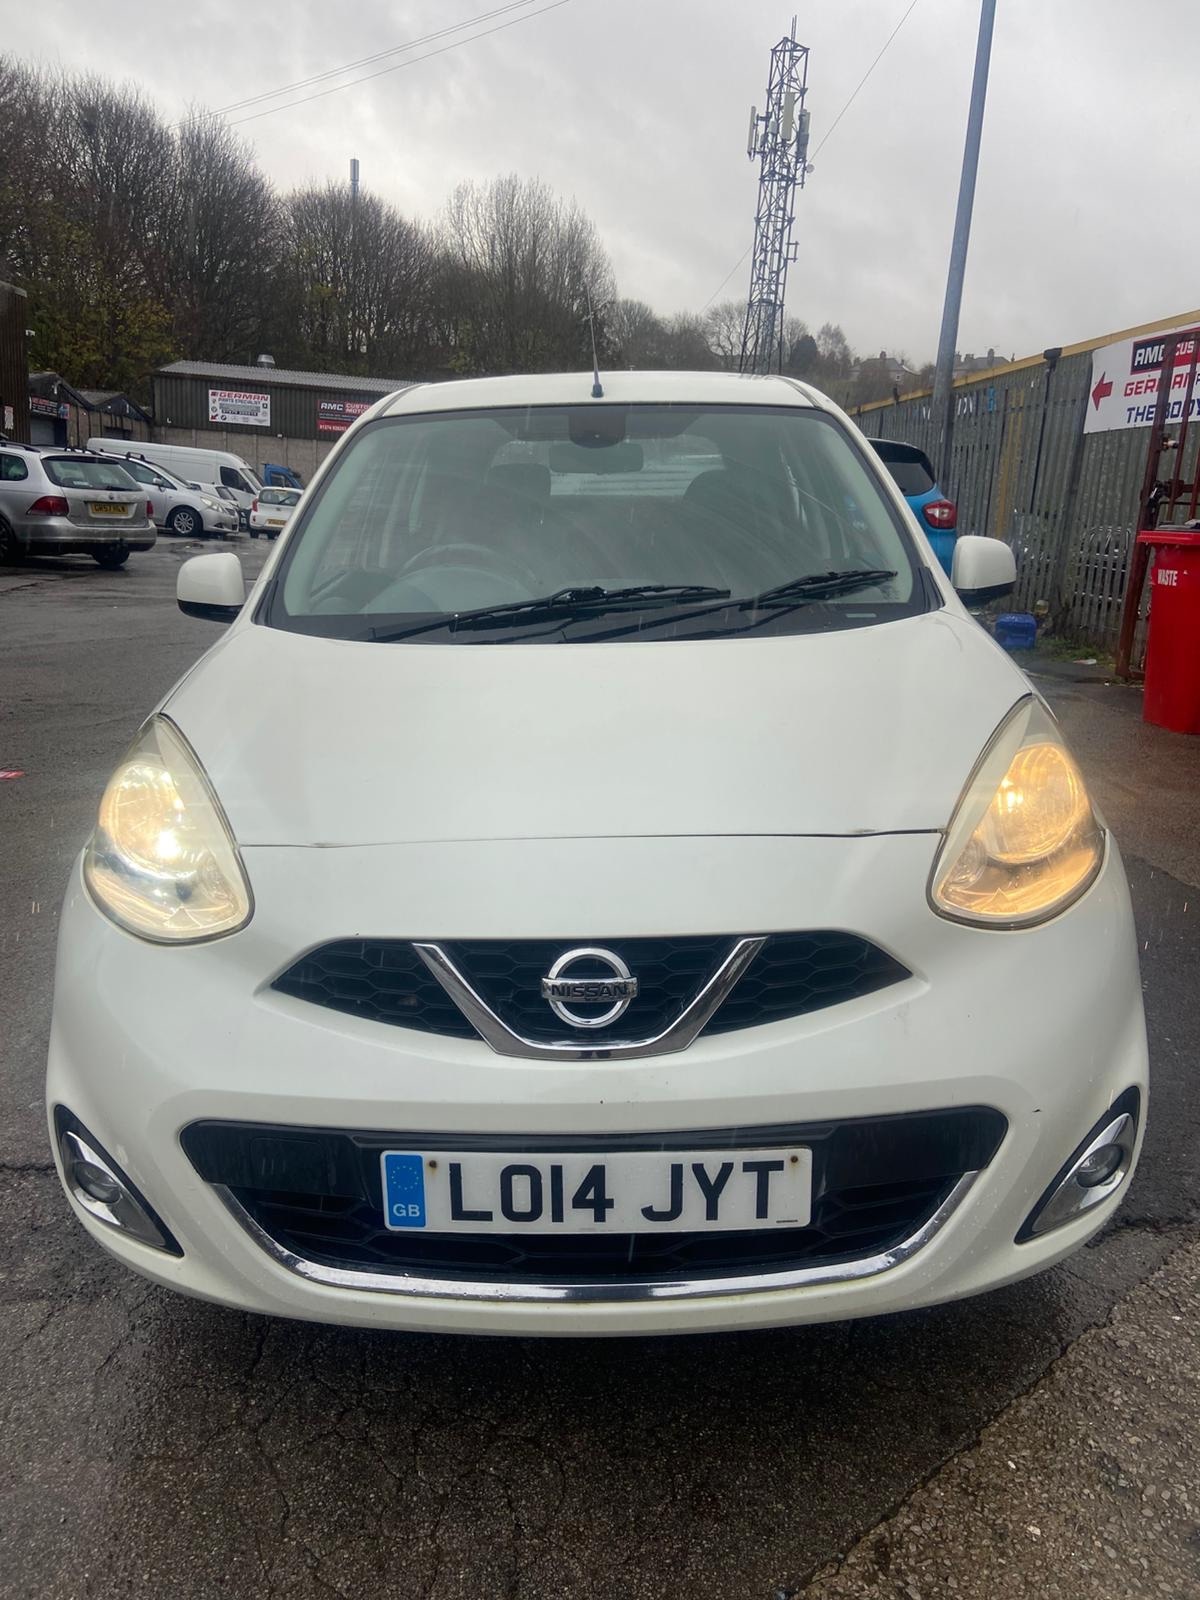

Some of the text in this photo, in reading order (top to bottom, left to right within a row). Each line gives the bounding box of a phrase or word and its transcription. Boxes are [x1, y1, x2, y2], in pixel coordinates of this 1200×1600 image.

[1124, 373, 1190, 397] GERAN
[220, 391, 269, 401] GERMAN
[1127, 404, 1156, 423] THE
[1157, 569, 1178, 587] WASTE
[551, 983, 628, 998] NISSAN
[449, 1160, 785, 1223] LO14 JYT
[393, 1203, 421, 1217] GB
